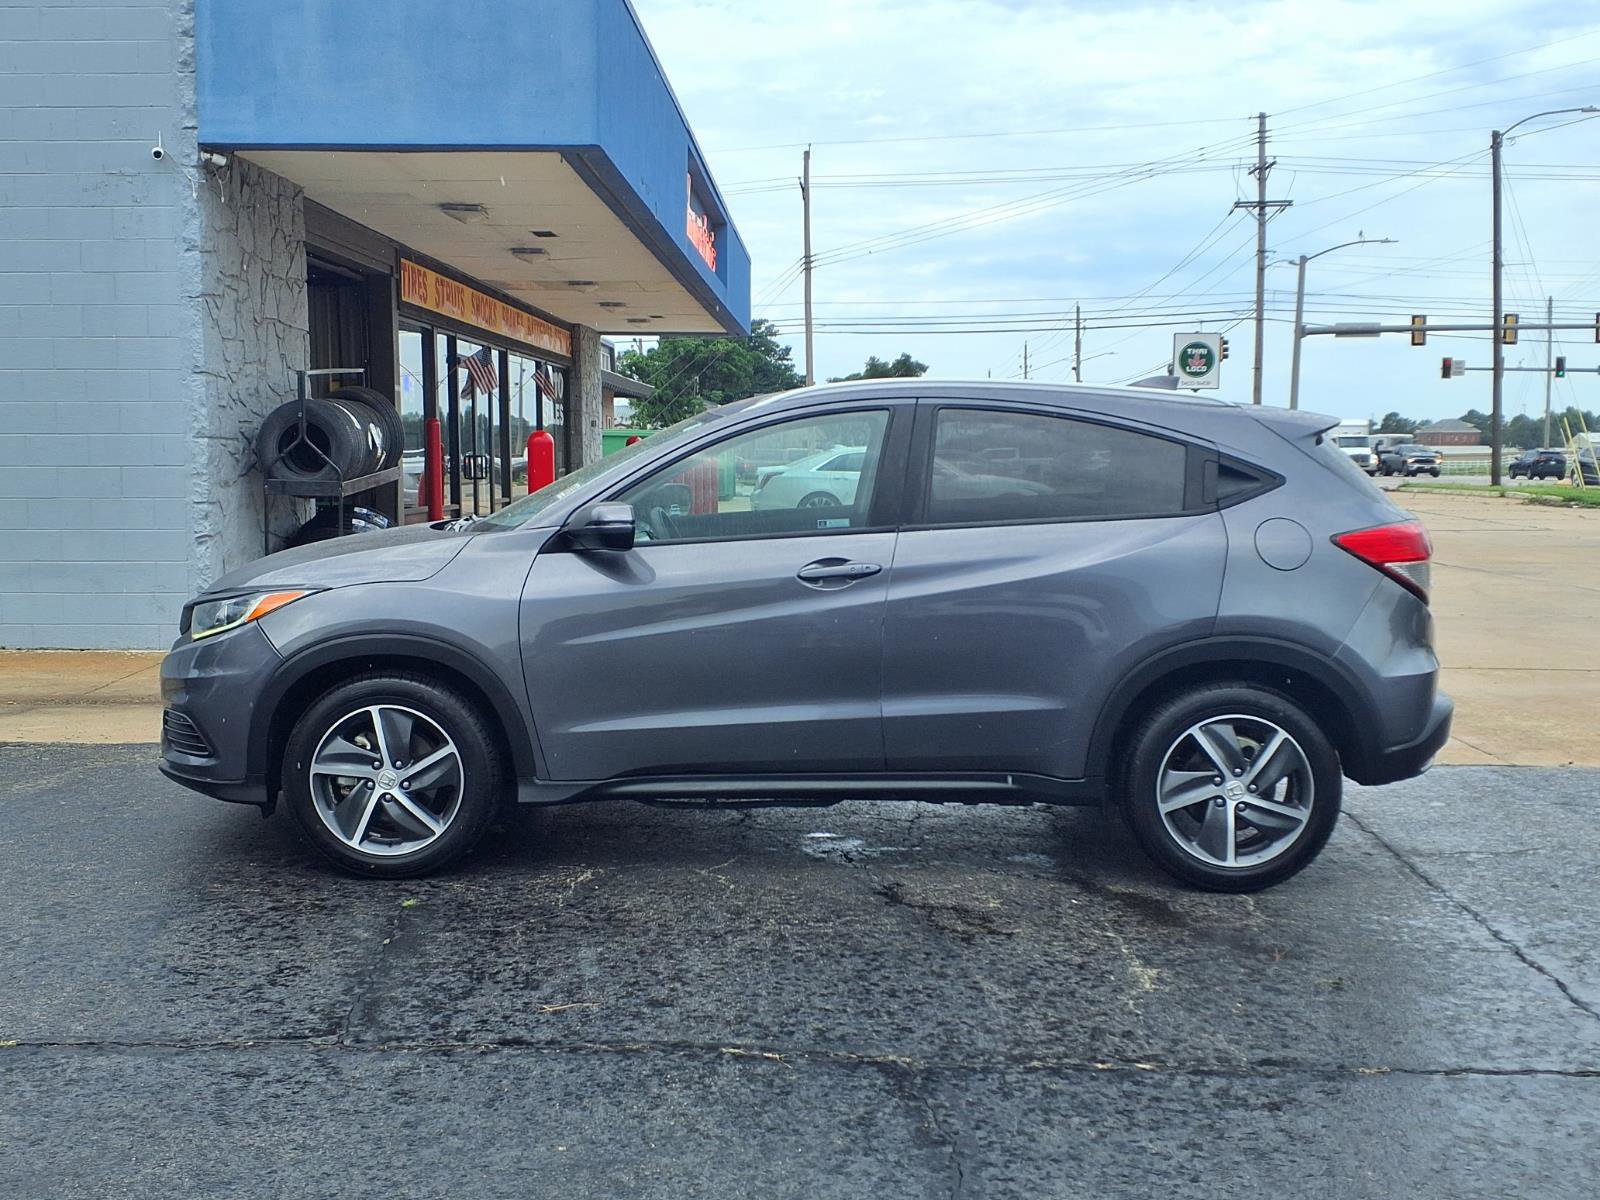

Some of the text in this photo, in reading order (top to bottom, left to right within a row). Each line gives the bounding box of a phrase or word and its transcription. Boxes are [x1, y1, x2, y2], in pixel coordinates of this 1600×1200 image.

[401, 262, 428, 305] TIRES
[434, 276, 465, 318] STRUTS
[471, 291, 497, 327] SHOCKS
